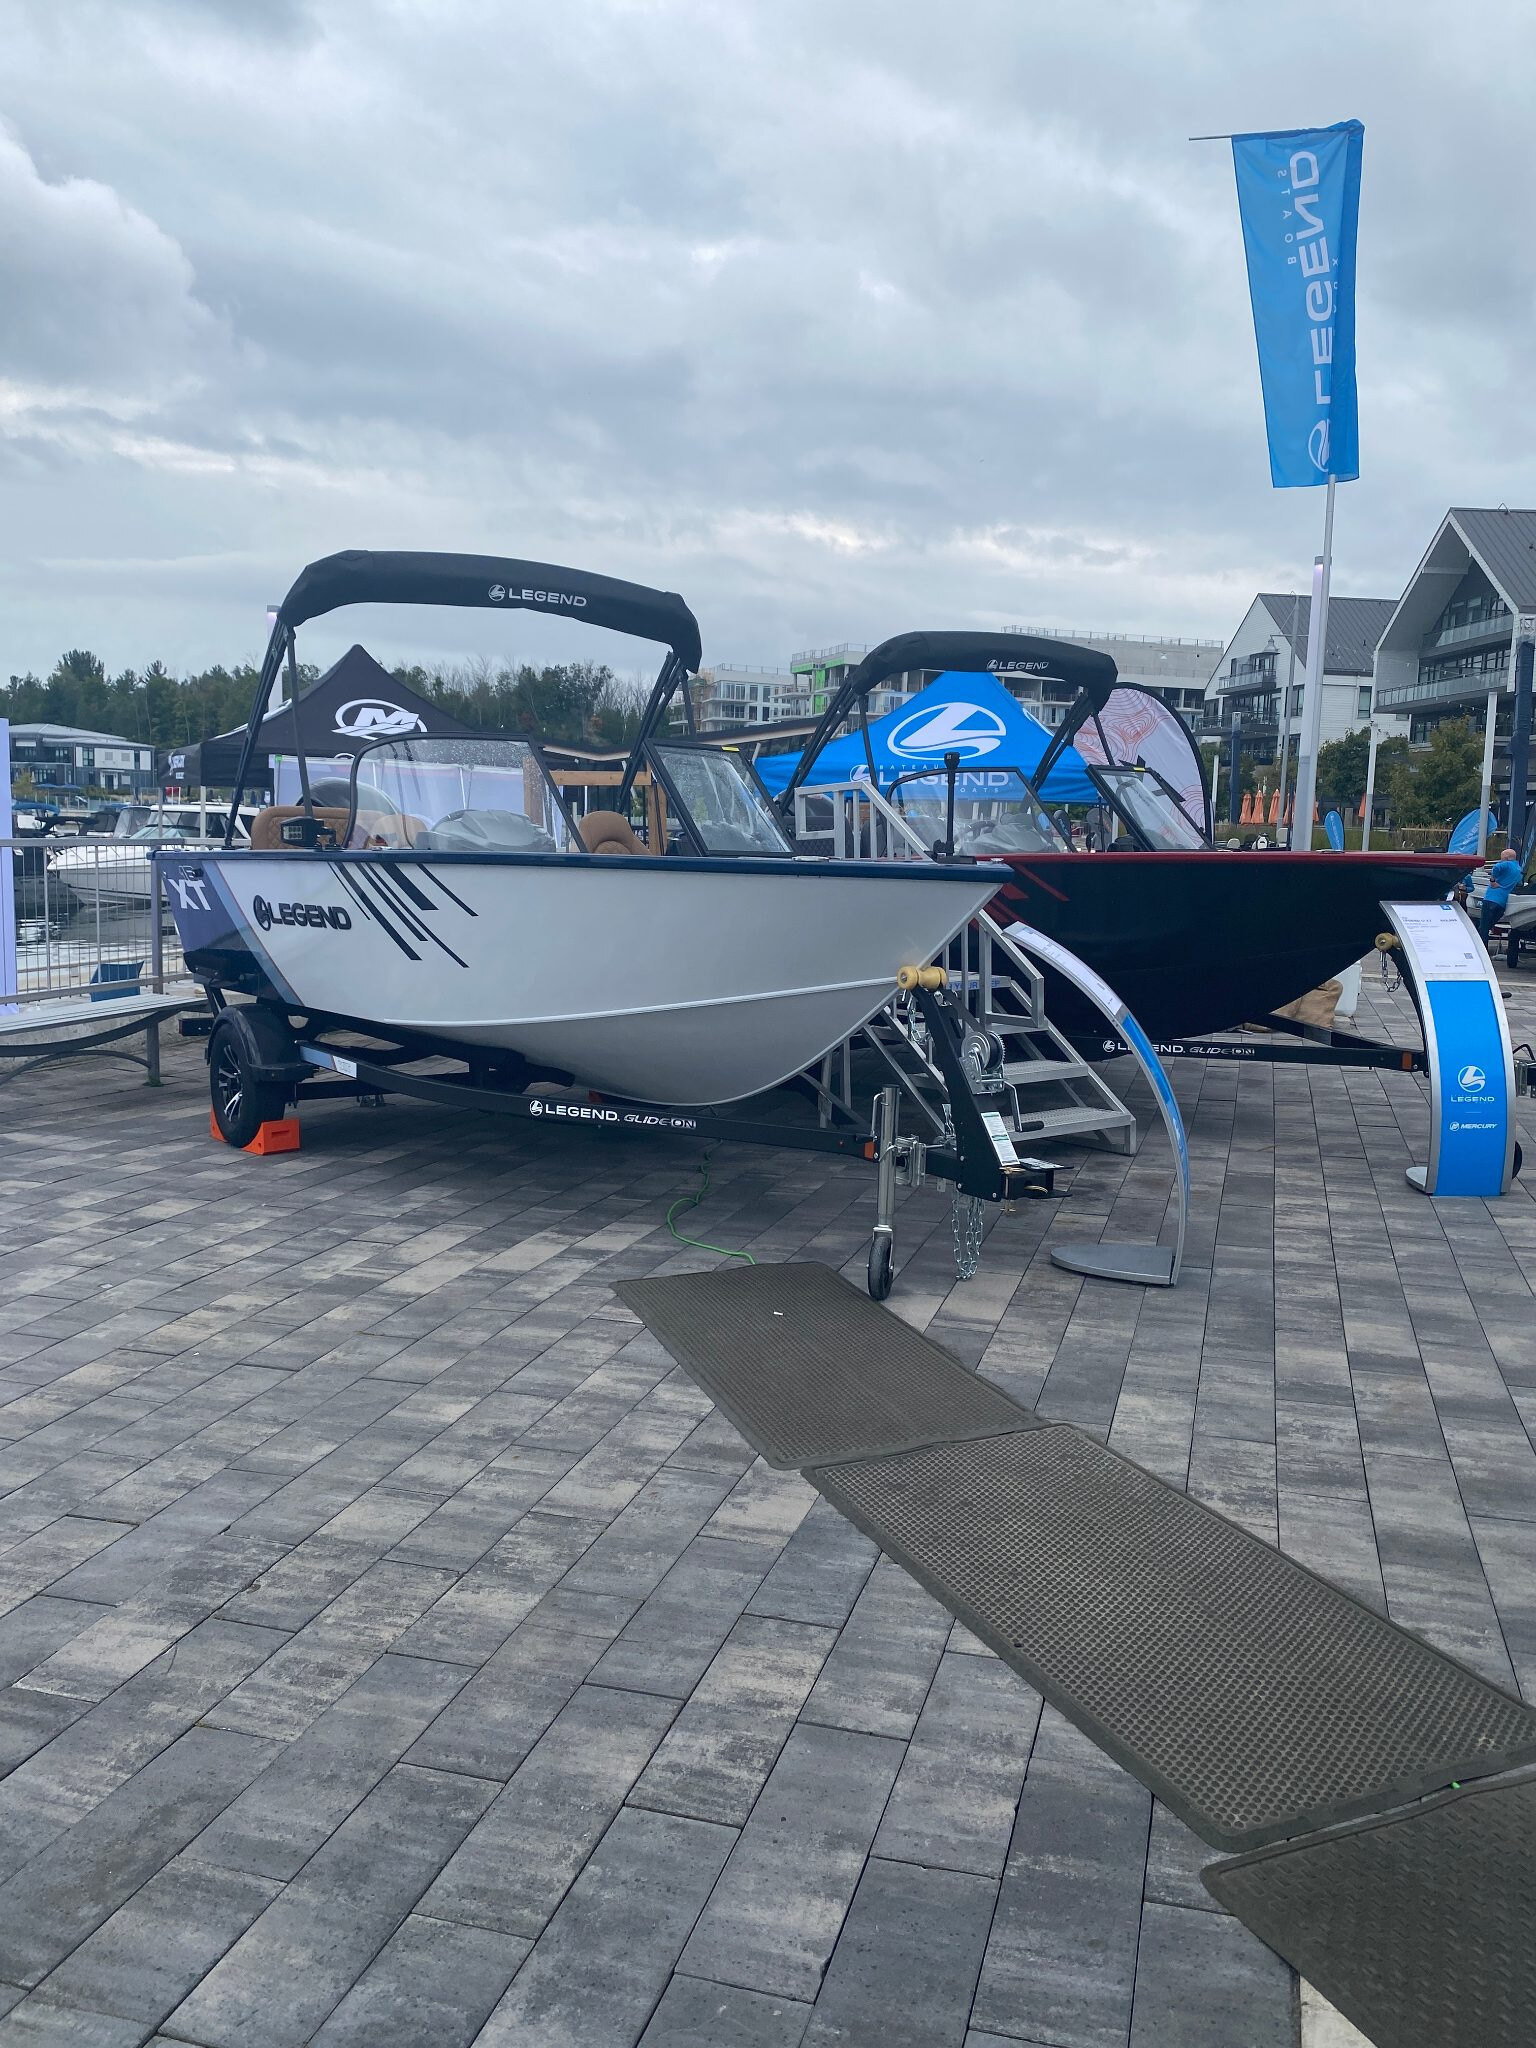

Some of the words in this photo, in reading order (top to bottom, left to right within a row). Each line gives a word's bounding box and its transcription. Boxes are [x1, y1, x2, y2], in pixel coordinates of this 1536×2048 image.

[508, 587, 587, 607] LEGEND
[998, 661, 1049, 670] LEGEND
[167, 879, 211, 911] XT
[267, 902, 352, 930] LEGEND
[1117, 1042, 1184, 1053] LEND
[1450, 1095, 1495, 1103] LEGEND
